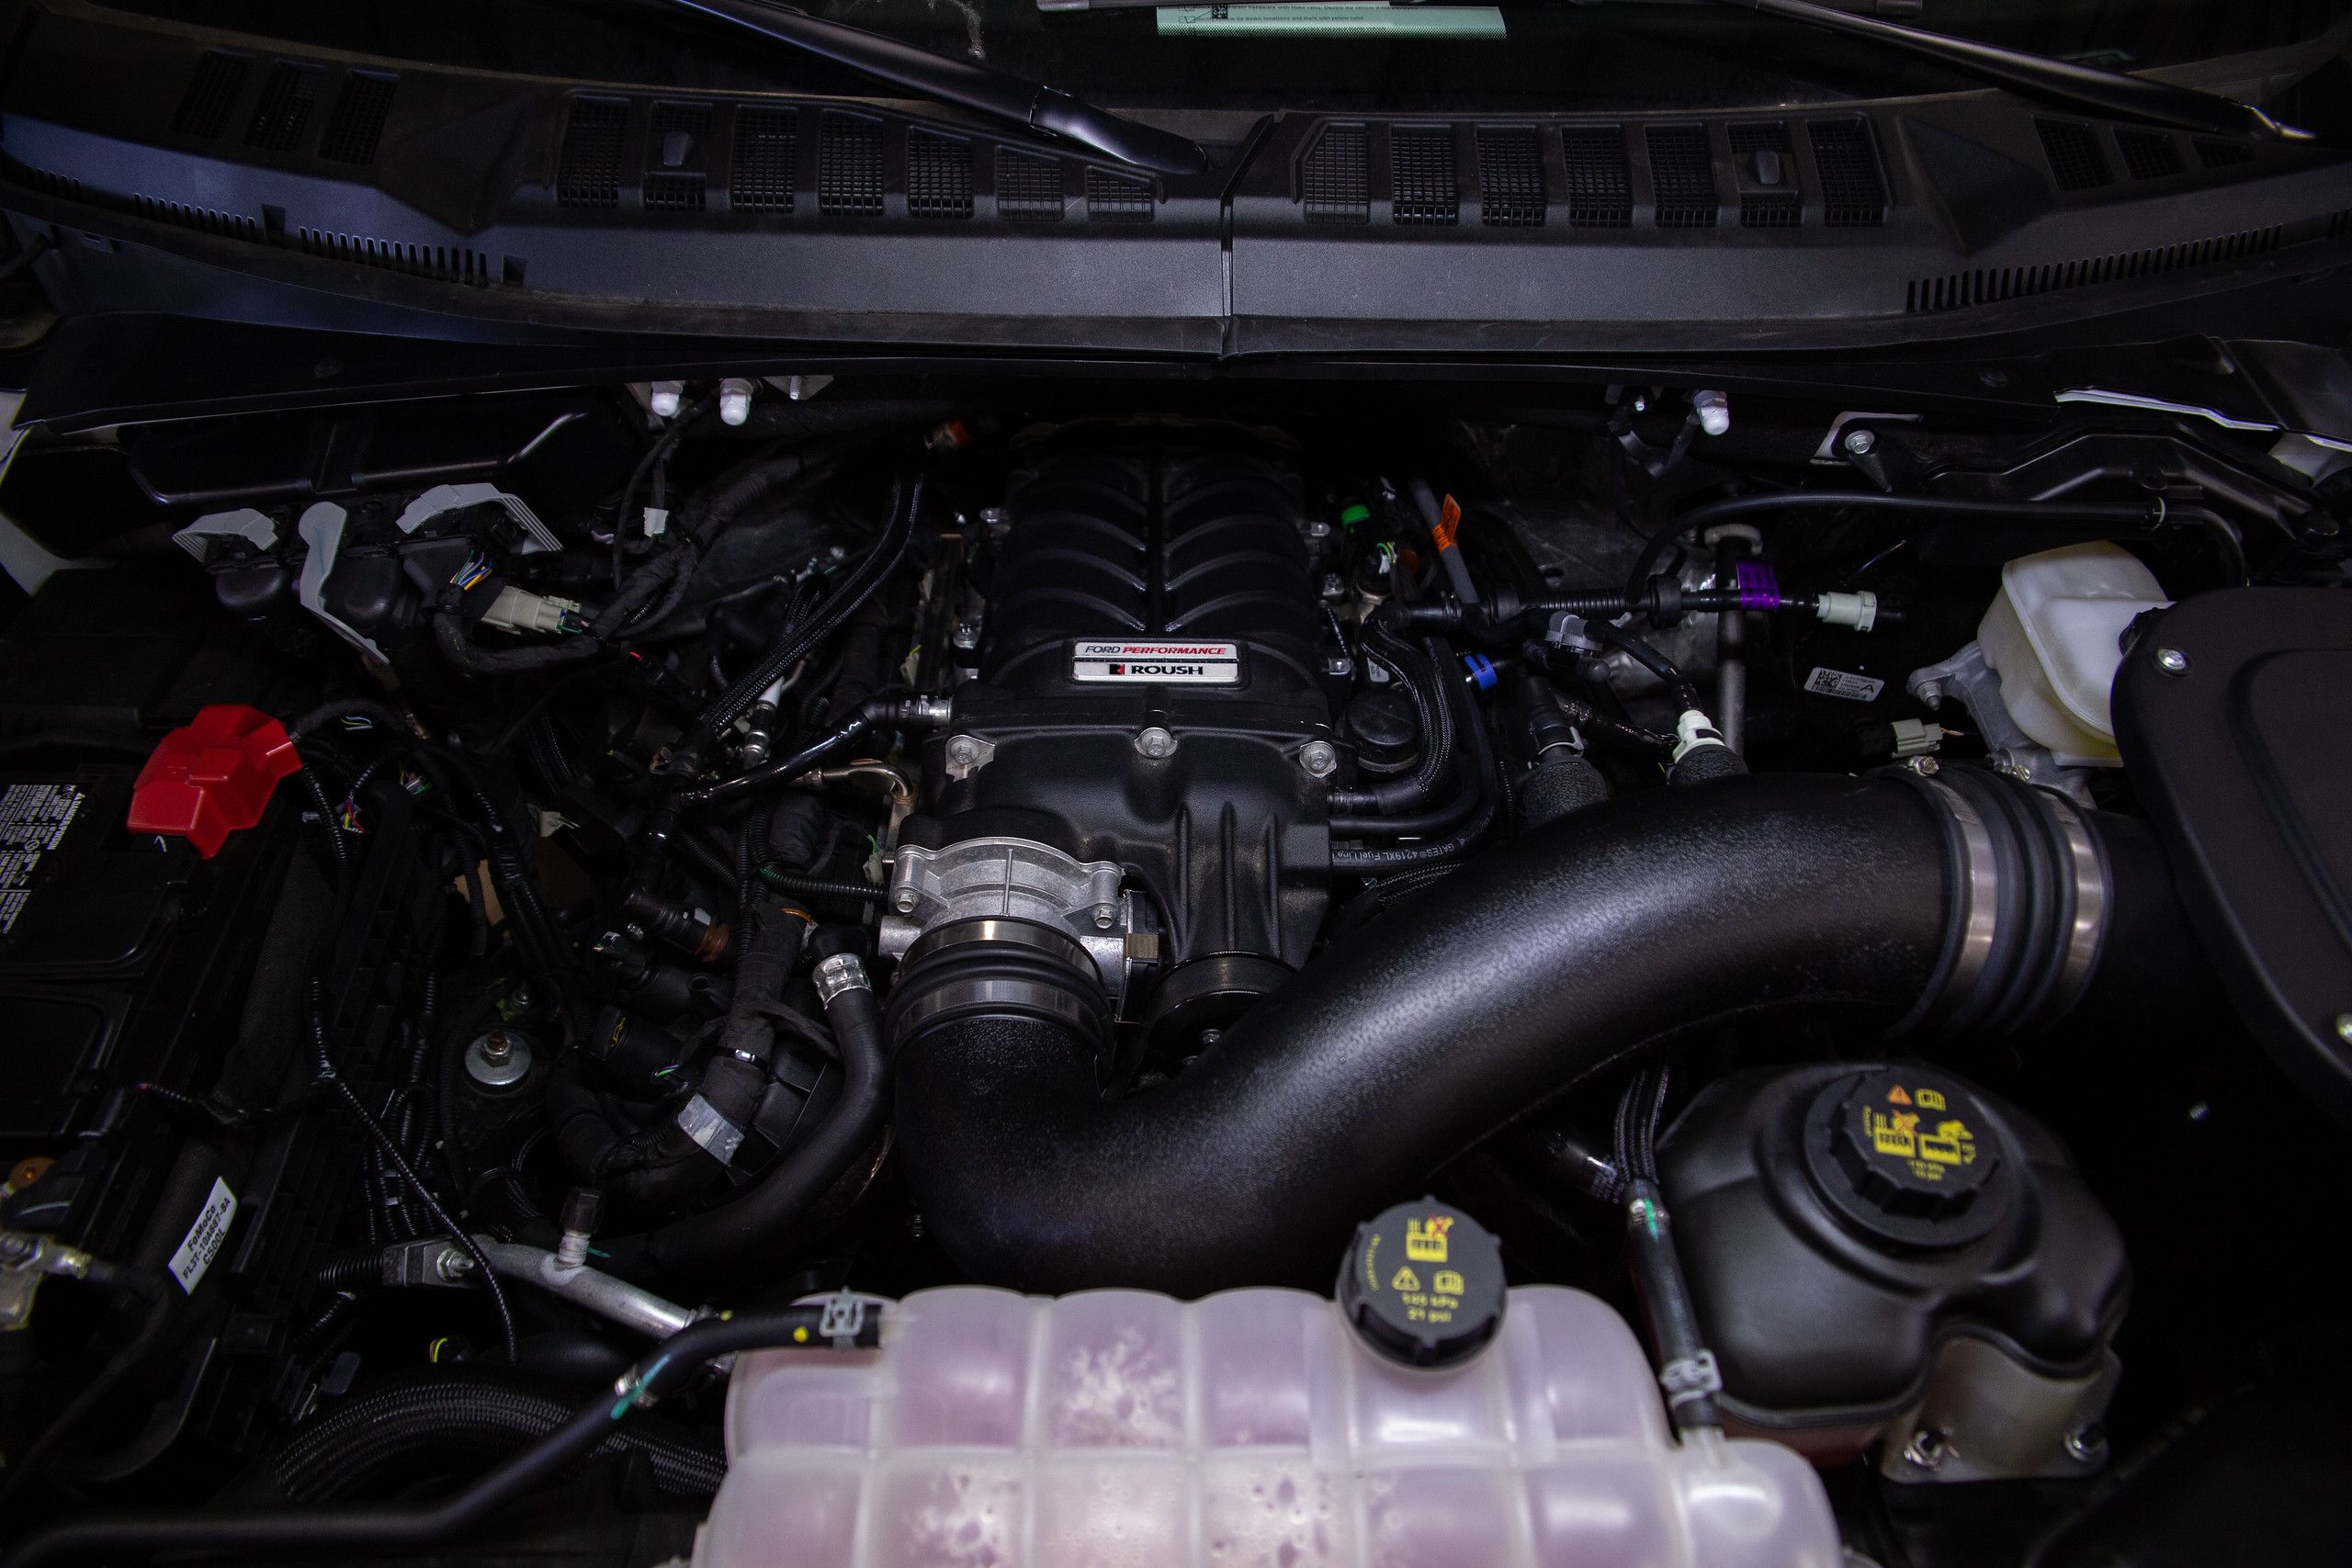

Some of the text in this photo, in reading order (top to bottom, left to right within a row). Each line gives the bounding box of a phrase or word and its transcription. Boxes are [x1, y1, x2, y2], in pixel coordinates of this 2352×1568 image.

[1085, 645, 1227, 655] FORD PERFORMANCE
[1131, 664, 1204, 675] ROUSH
[1382, 849, 1418, 862] 4219XL
[187, 1204, 217, 1252] FoMoCo
